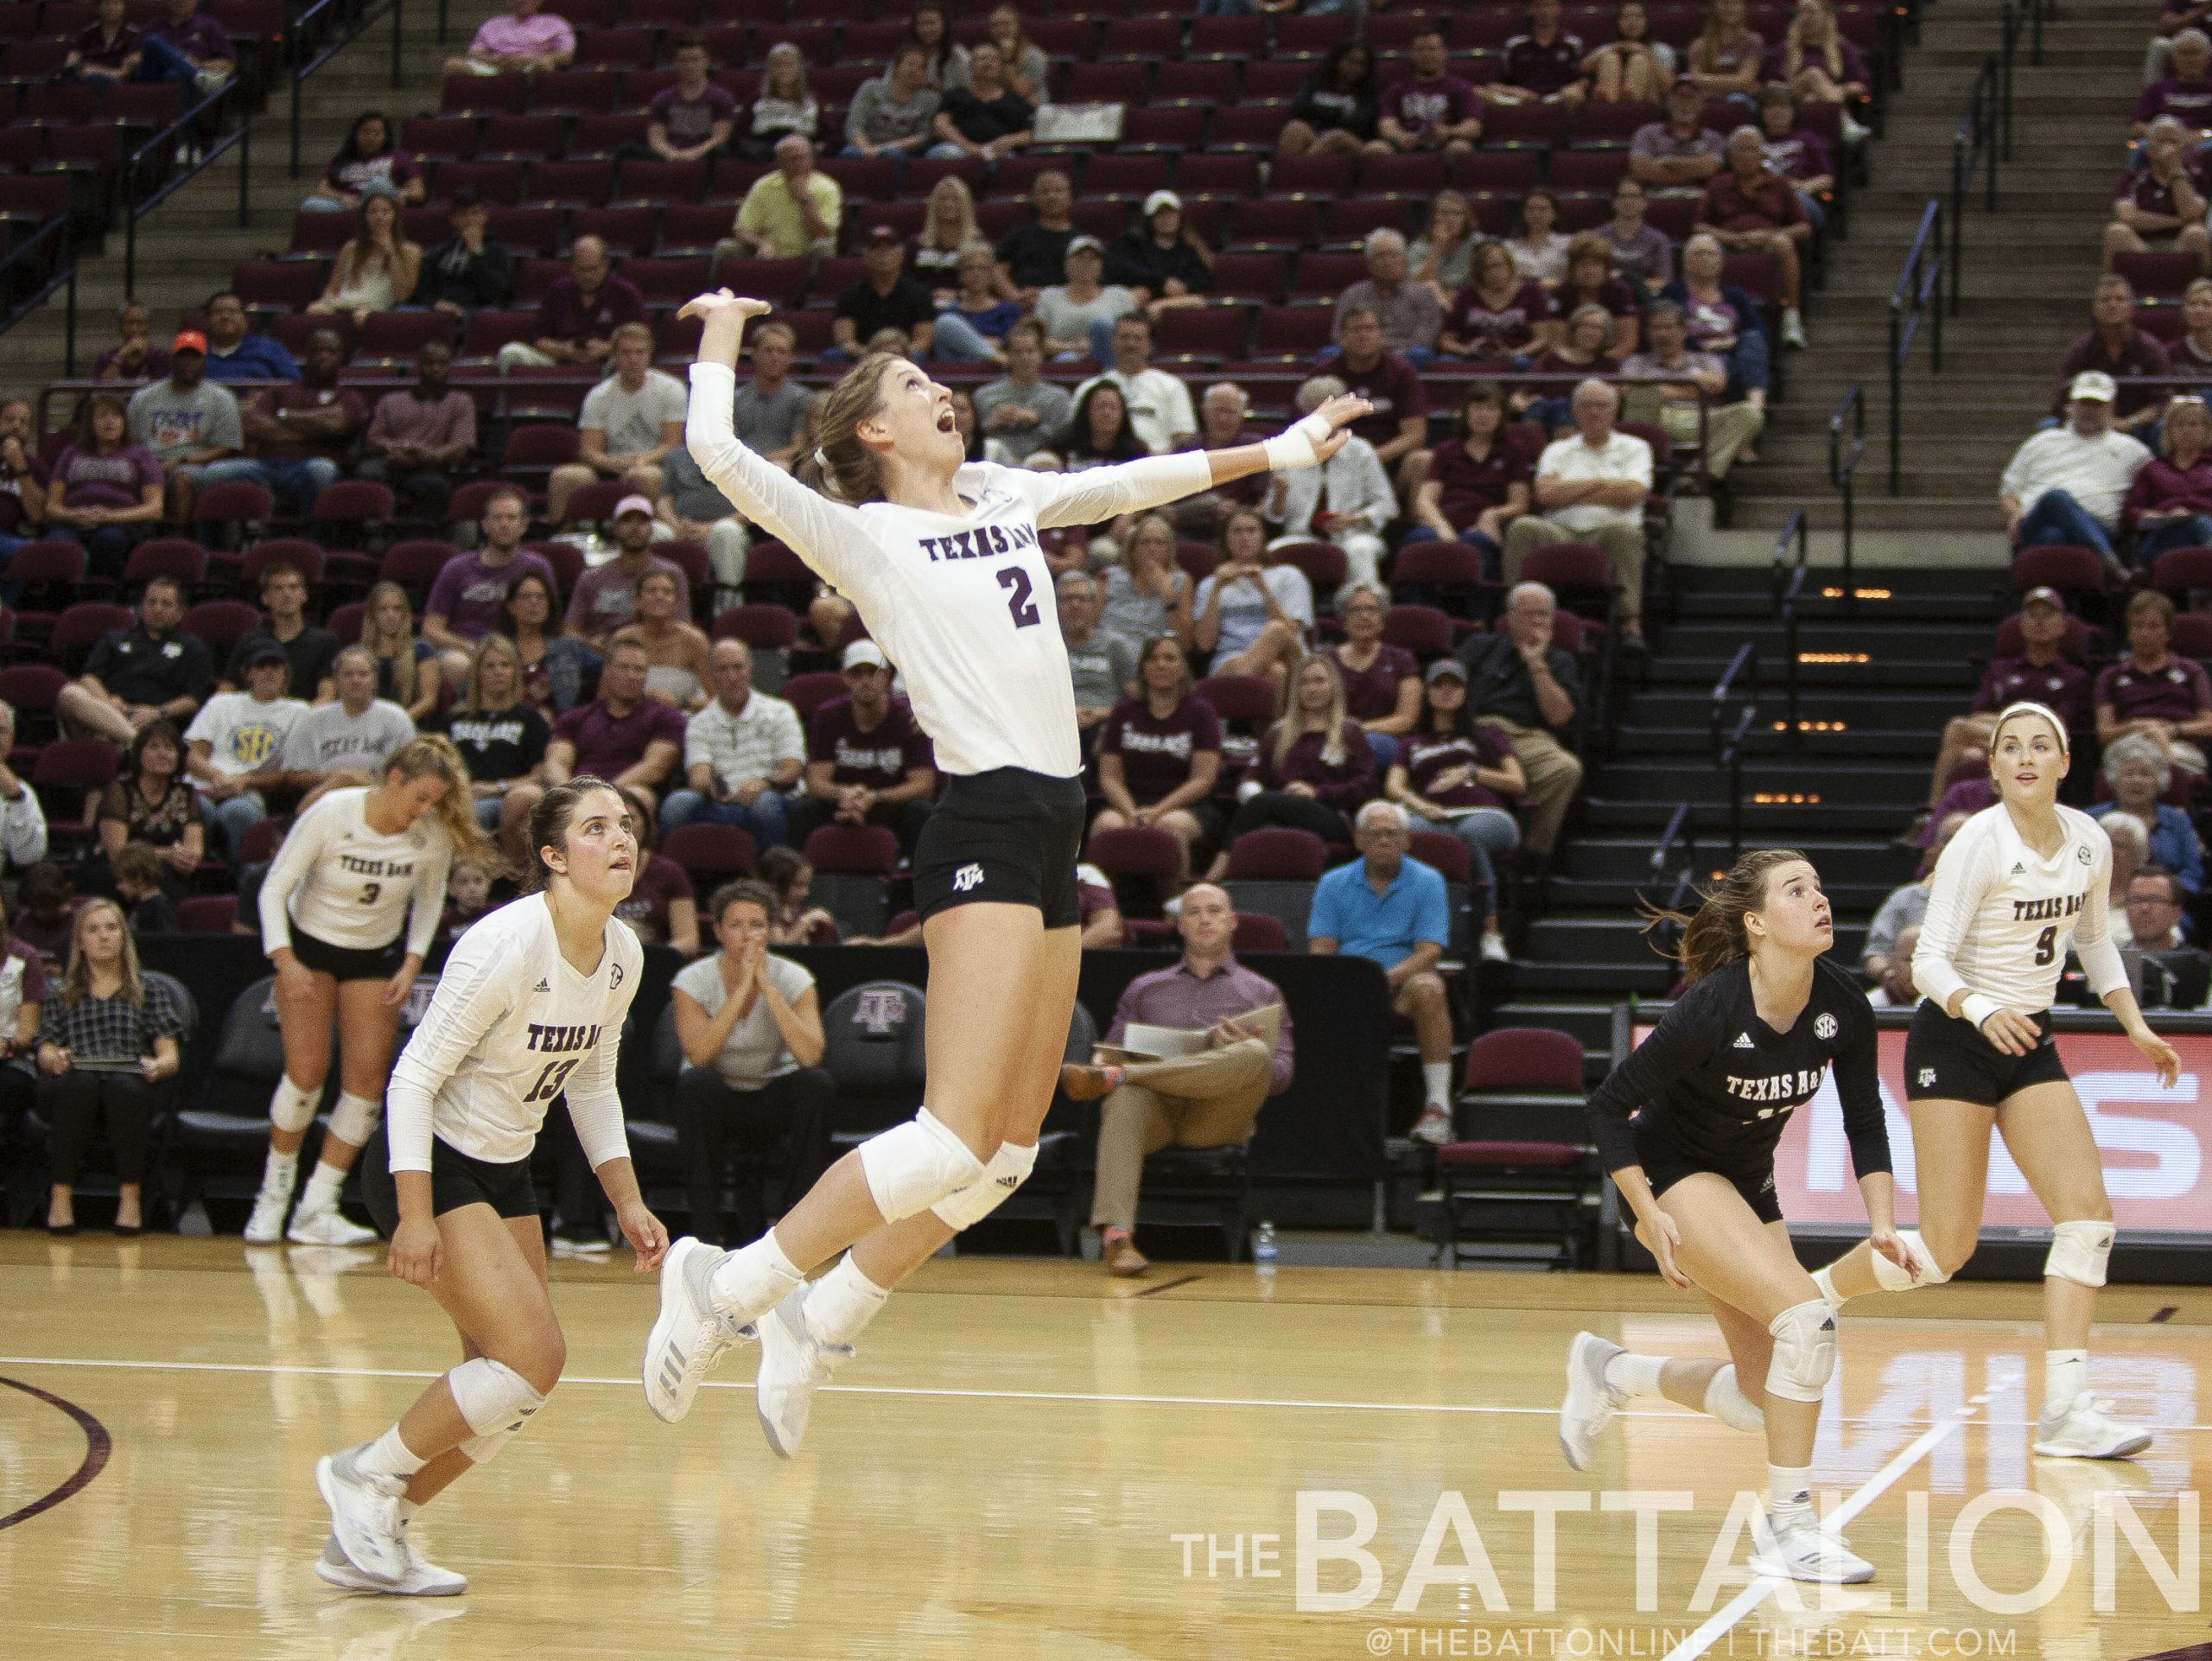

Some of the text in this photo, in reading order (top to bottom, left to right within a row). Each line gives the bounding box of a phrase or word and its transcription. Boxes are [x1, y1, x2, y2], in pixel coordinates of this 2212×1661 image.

[918, 525, 1009, 561] TEXAS
[996, 566, 1040, 628] 2
[339, 854, 382, 876] TEXAS
[359, 883, 381, 905] 3
[2014, 896, 2063, 921] TEXAS
[2035, 926, 2057, 965] 9
[527, 1023, 586, 1053] TEXAS
[1816, 1015, 1836, 1039] SEC
[523, 1059, 580, 1103] 13
[1727, 1074, 1792, 1101] TEXAS
